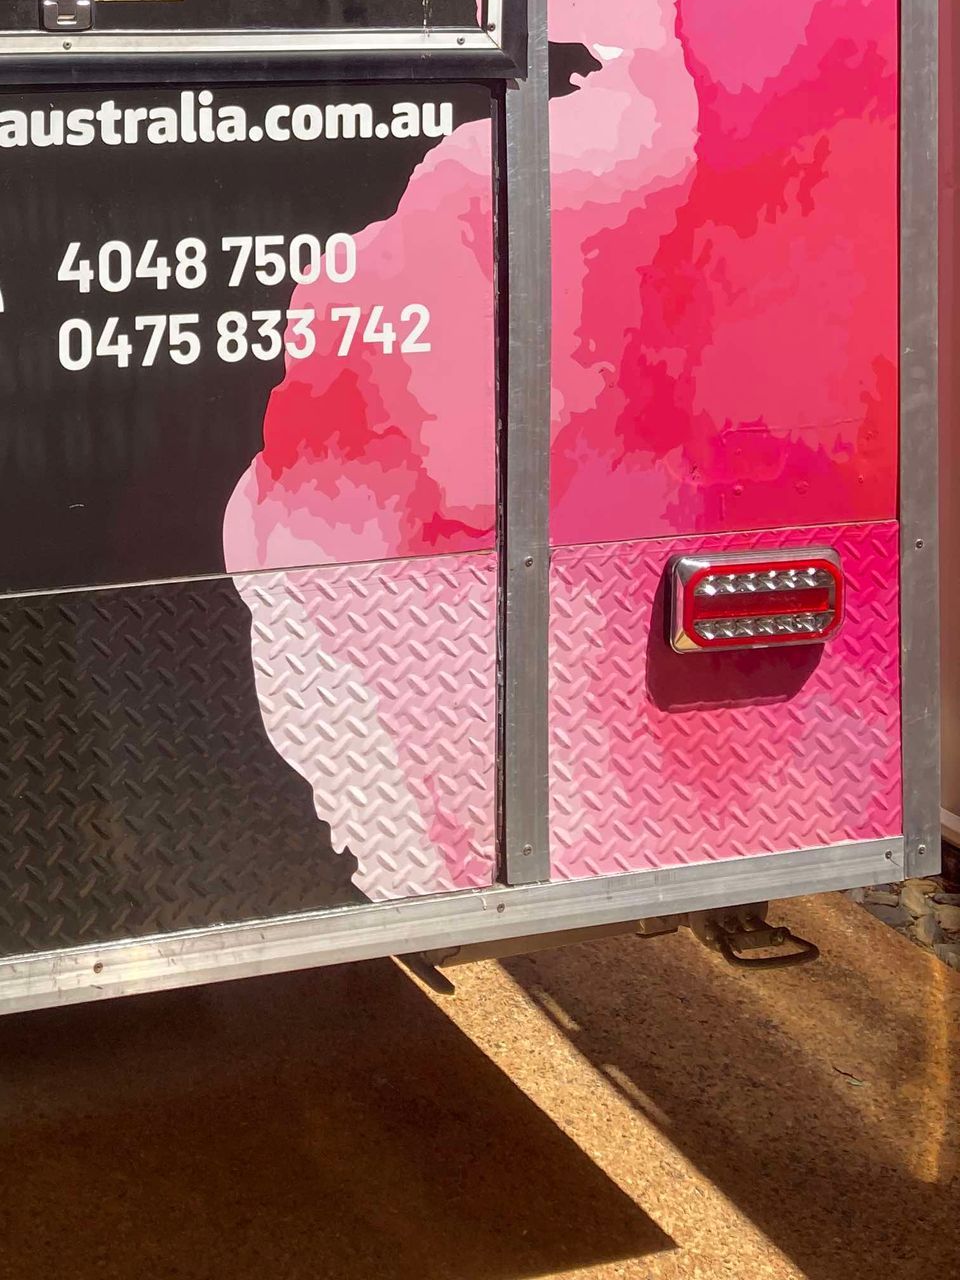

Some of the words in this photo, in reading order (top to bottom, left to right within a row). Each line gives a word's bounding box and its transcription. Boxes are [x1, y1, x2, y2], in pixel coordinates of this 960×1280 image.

[57, 238, 208, 293] 4048
[224, 232, 357, 287] 7500
[58, 313, 201, 371] 0475
[216, 308, 317, 365] 833
[331, 303, 432, 357] 742
